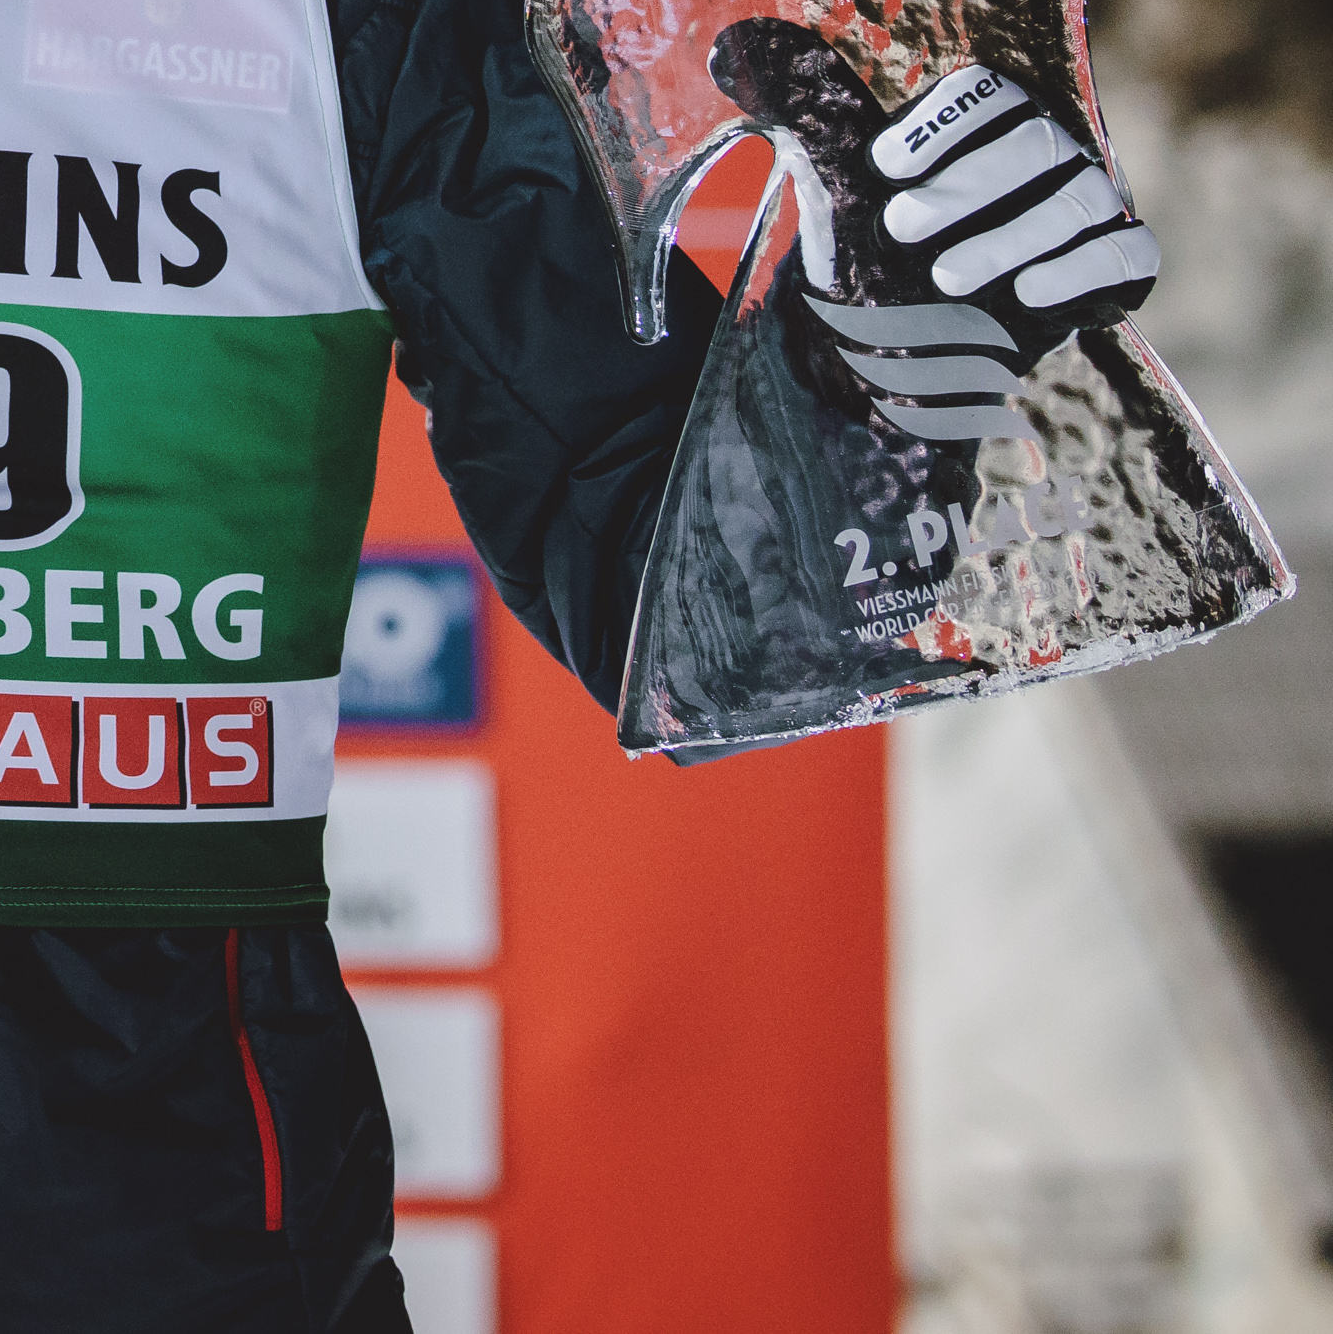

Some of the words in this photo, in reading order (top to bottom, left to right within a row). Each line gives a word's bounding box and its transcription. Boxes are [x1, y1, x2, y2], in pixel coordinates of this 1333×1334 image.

[834, 528, 898, 587] 2.
[906, 474, 1091, 568] PLACE
[856, 574, 958, 617] VIESSMANN
[854, 612, 921, 644] WORLD
